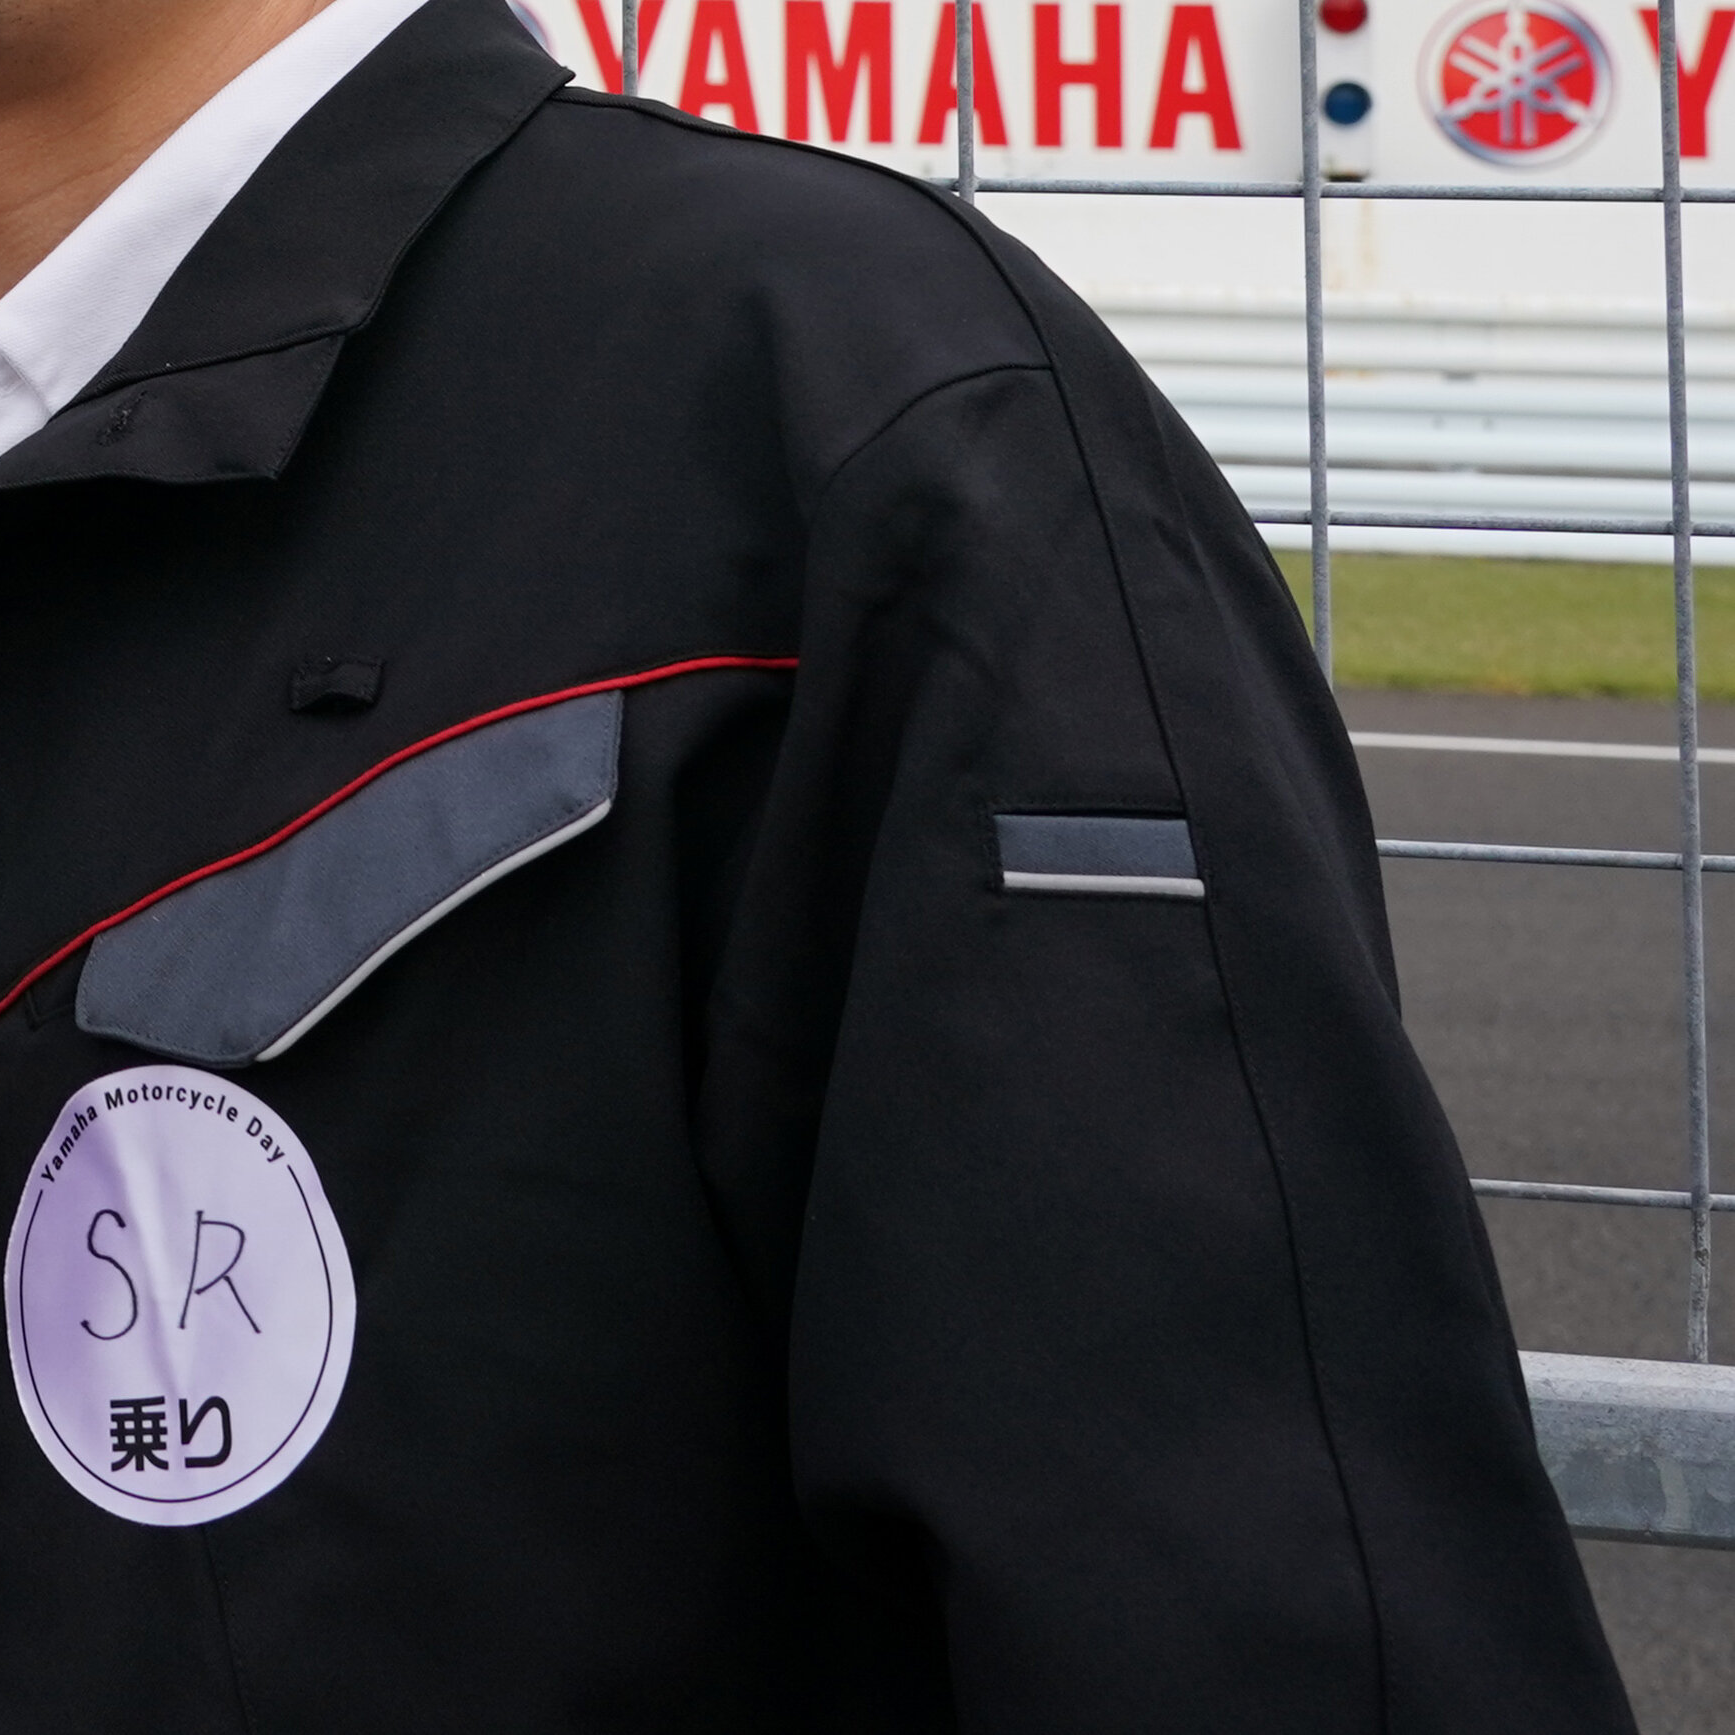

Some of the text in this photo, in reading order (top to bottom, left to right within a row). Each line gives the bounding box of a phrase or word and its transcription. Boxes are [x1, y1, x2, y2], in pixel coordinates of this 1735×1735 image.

[40, 1082, 286, 1184] Yamaha Motorcycle Day
[108, 1394, 234, 1472] 乗り
